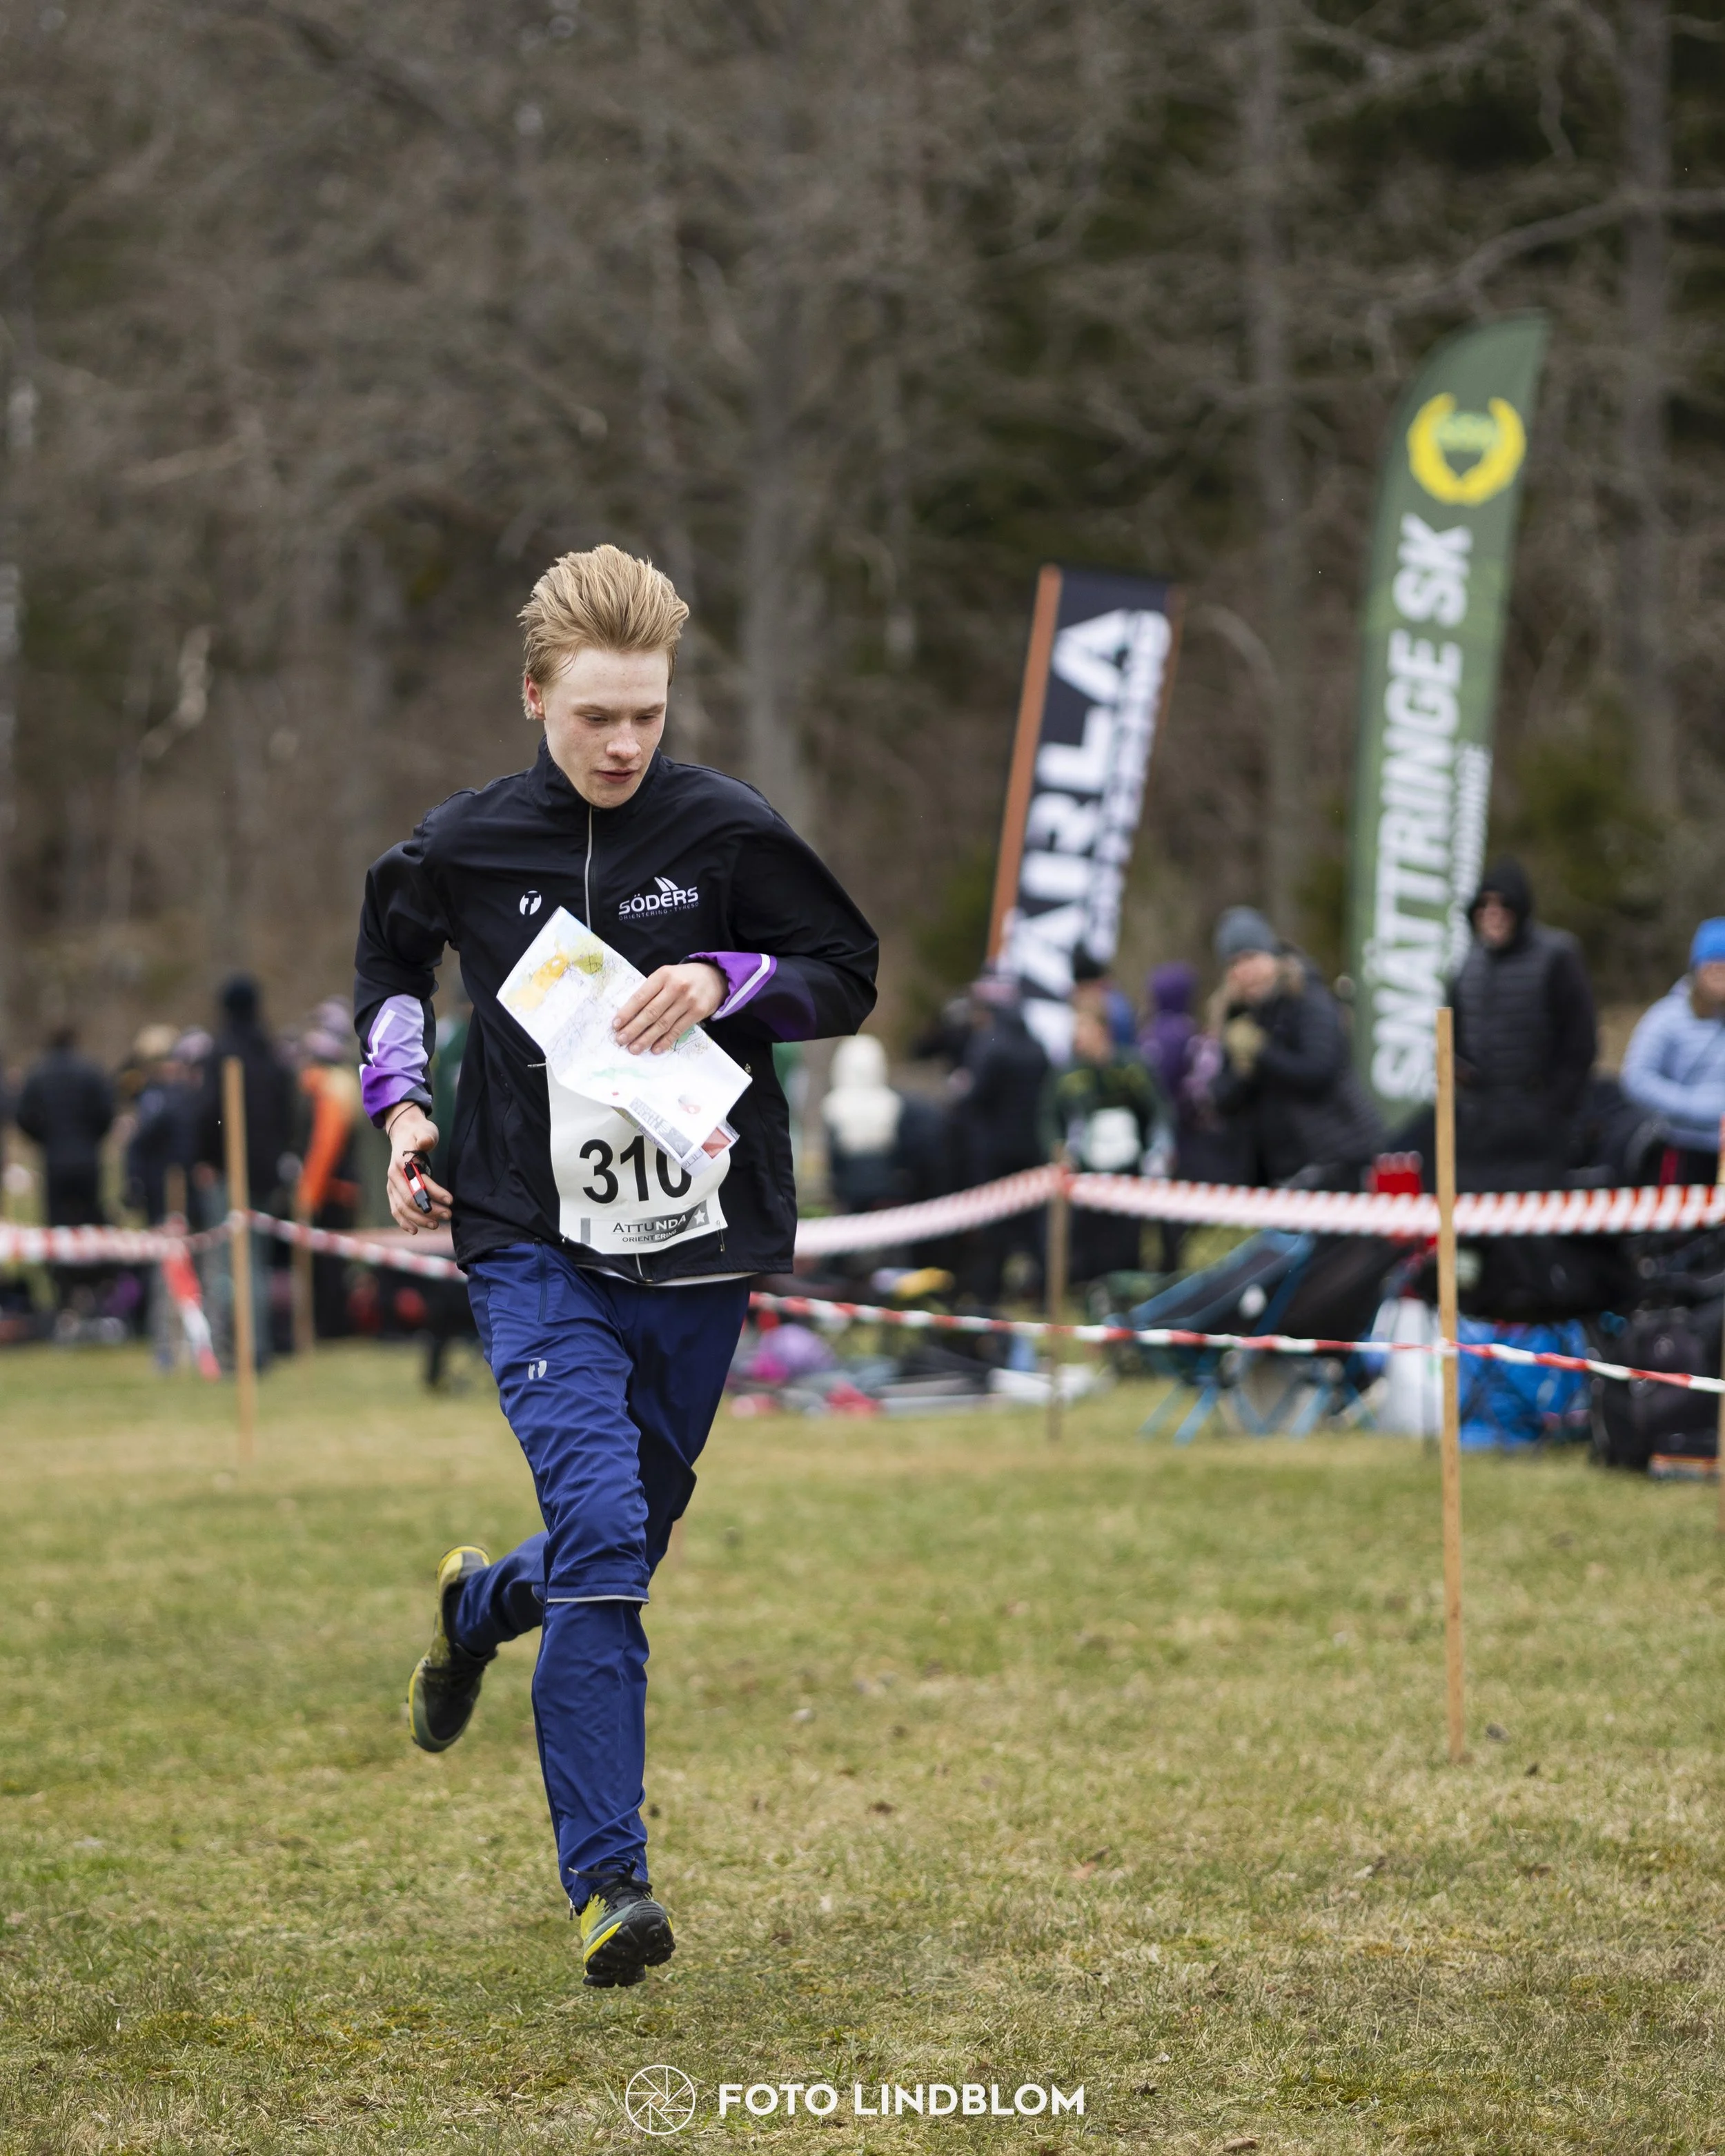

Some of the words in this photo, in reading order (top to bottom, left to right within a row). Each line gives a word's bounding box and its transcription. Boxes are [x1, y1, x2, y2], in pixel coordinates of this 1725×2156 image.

[1392, 512, 1472, 628] SK
[1362, 628, 1463, 1102] SNÄTTRINGE
[618, 887, 698, 915] SÖDERS
[618, 909, 668, 920] ORIENTERING
[579, 1134, 692, 1204] 310
[613, 1214, 687, 1233] ATTUNDA
[622, 1229, 677, 1243] ORIENTERING
